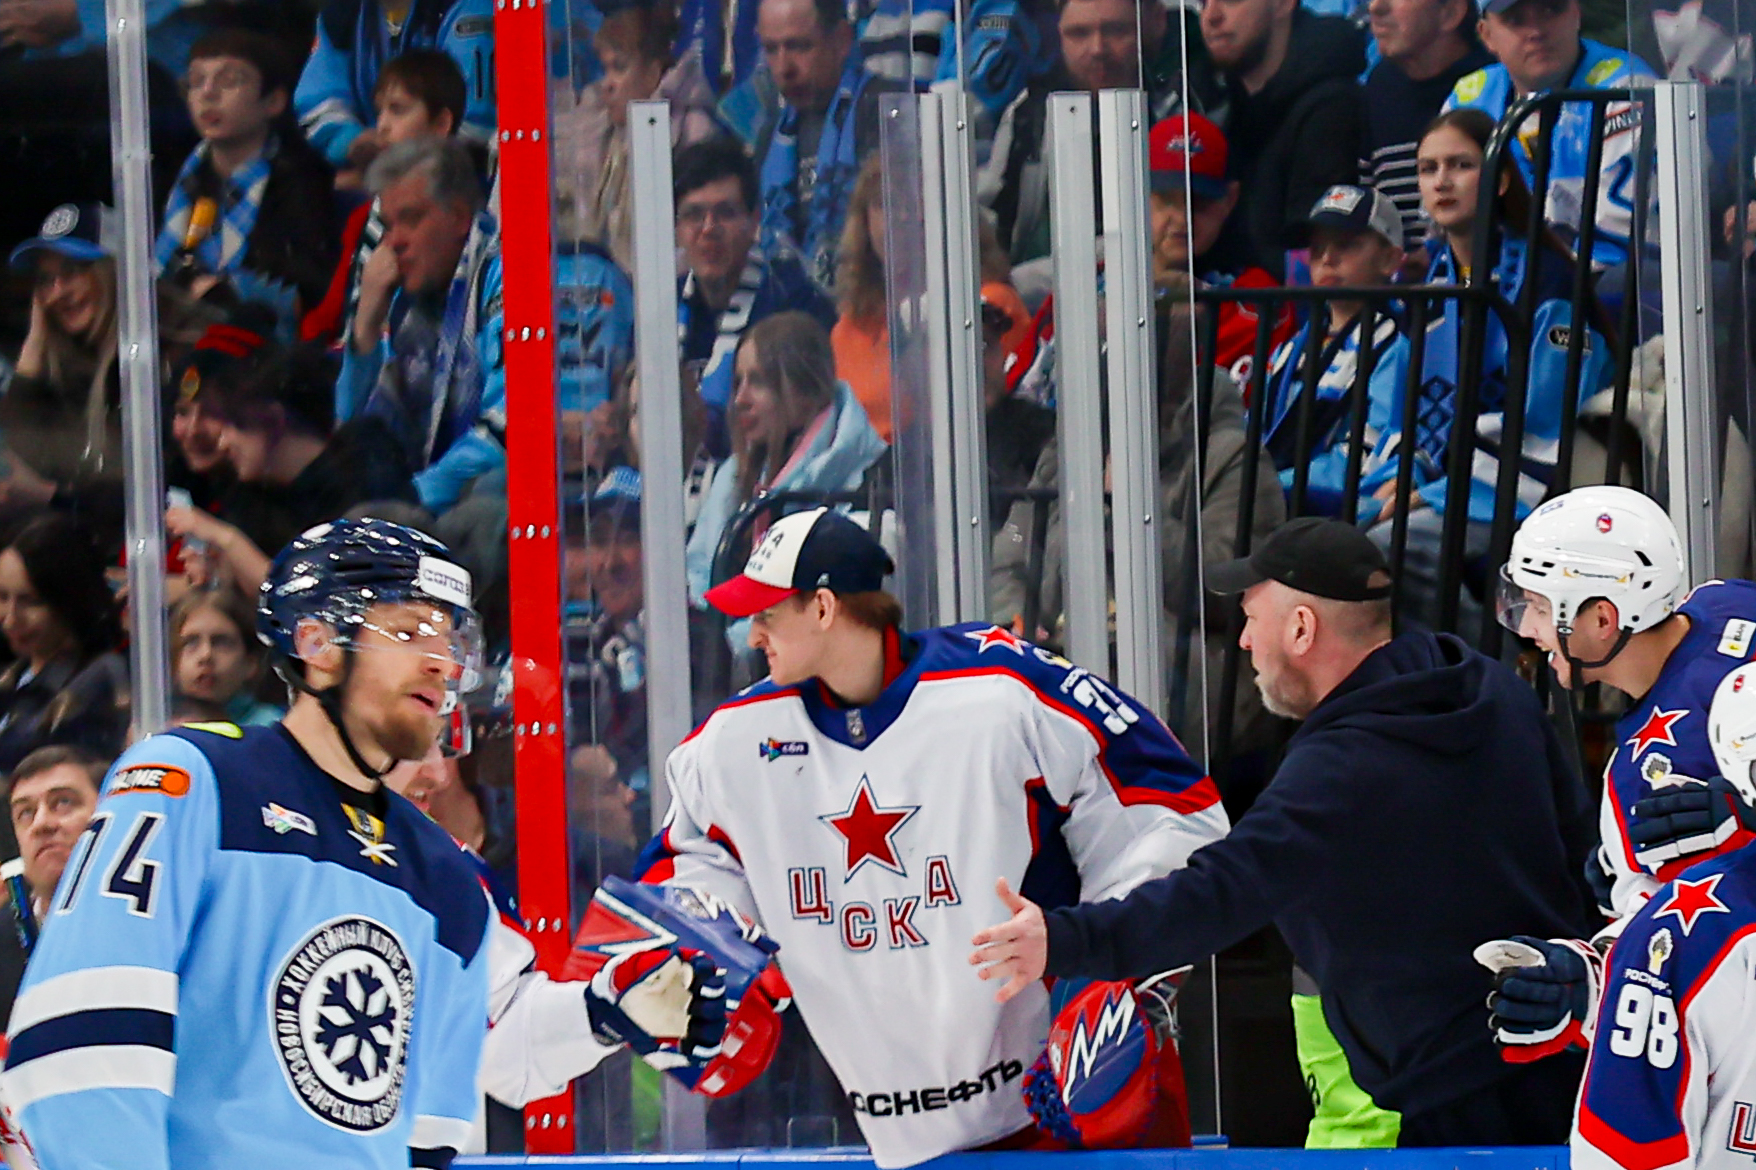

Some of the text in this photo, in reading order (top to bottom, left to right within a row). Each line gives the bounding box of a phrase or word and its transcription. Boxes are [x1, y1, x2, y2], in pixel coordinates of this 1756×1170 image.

[788, 854, 961, 954] ЦСКА
[1610, 982, 1680, 1070] 98
[848, 1058, 1024, 1118] ОСНЕФТЬ
